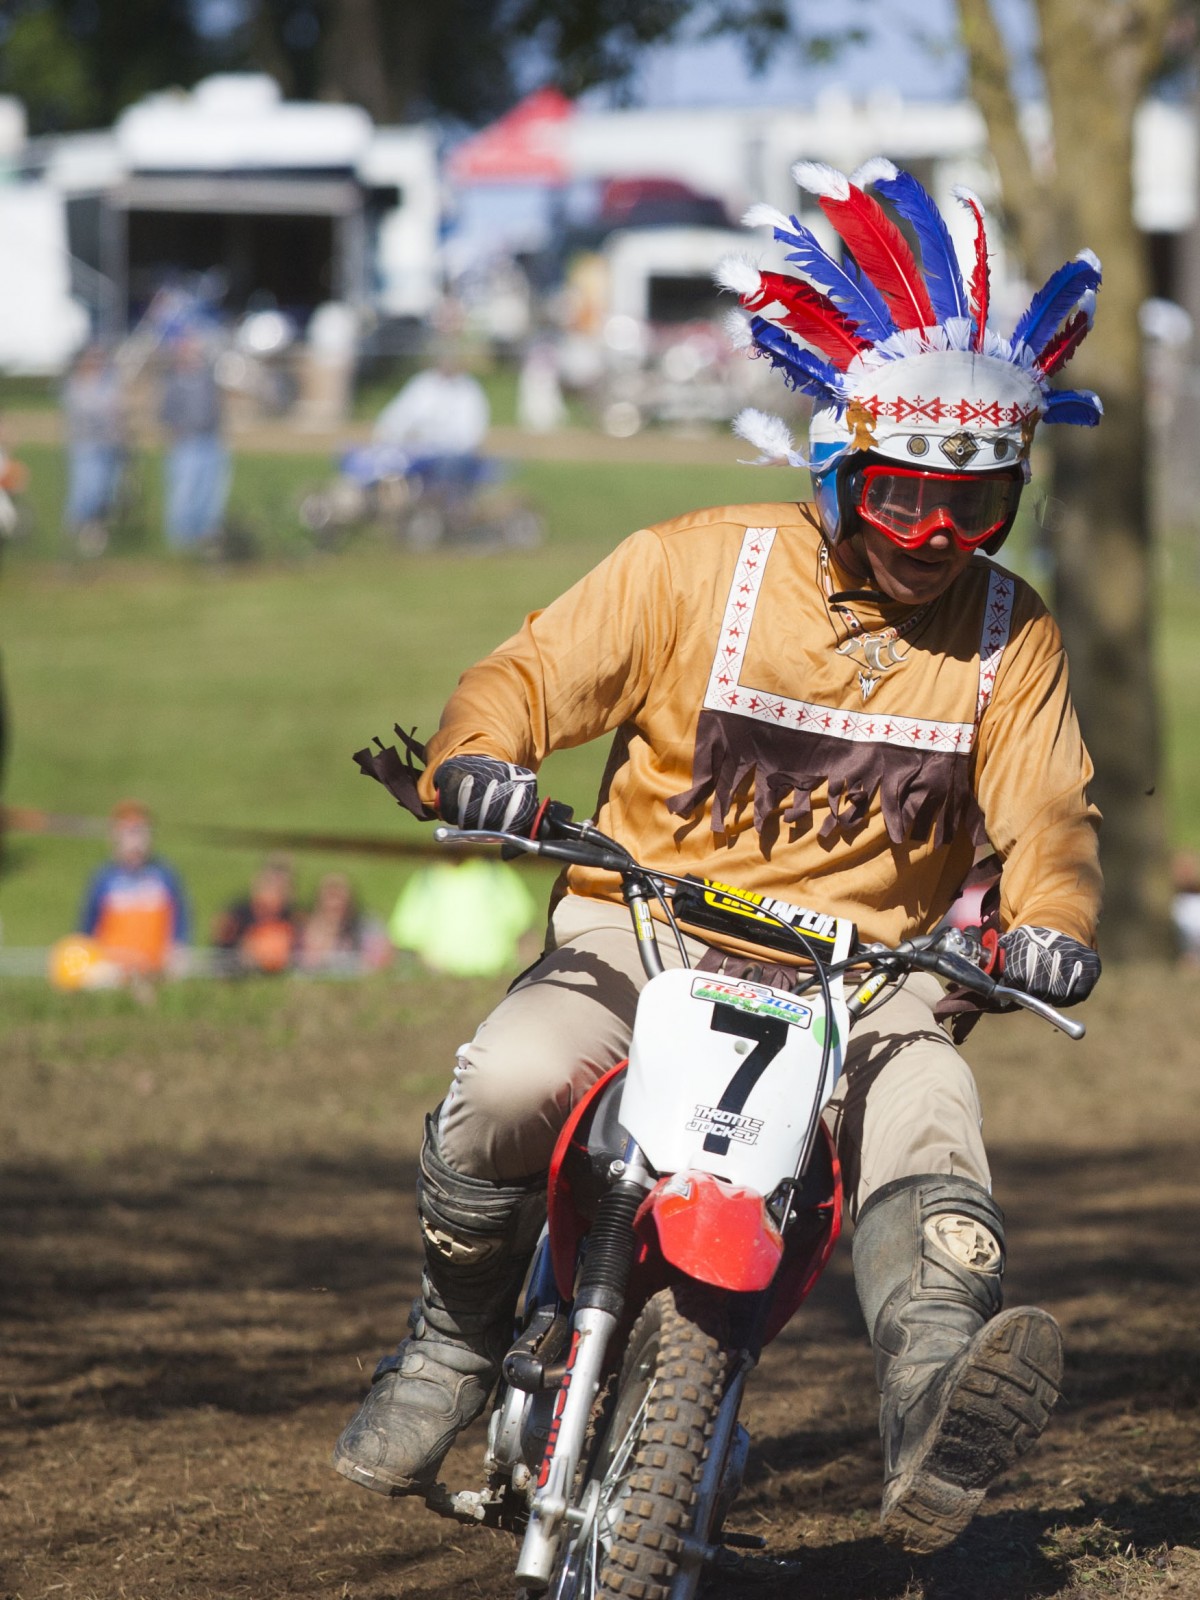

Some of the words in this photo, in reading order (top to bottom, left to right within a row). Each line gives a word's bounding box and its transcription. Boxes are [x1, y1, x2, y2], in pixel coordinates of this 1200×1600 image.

[703, 1000, 790, 1156] 7
[685, 1118, 758, 1145] JOCKEY
[694, 1104, 764, 1132] THROTTLE
